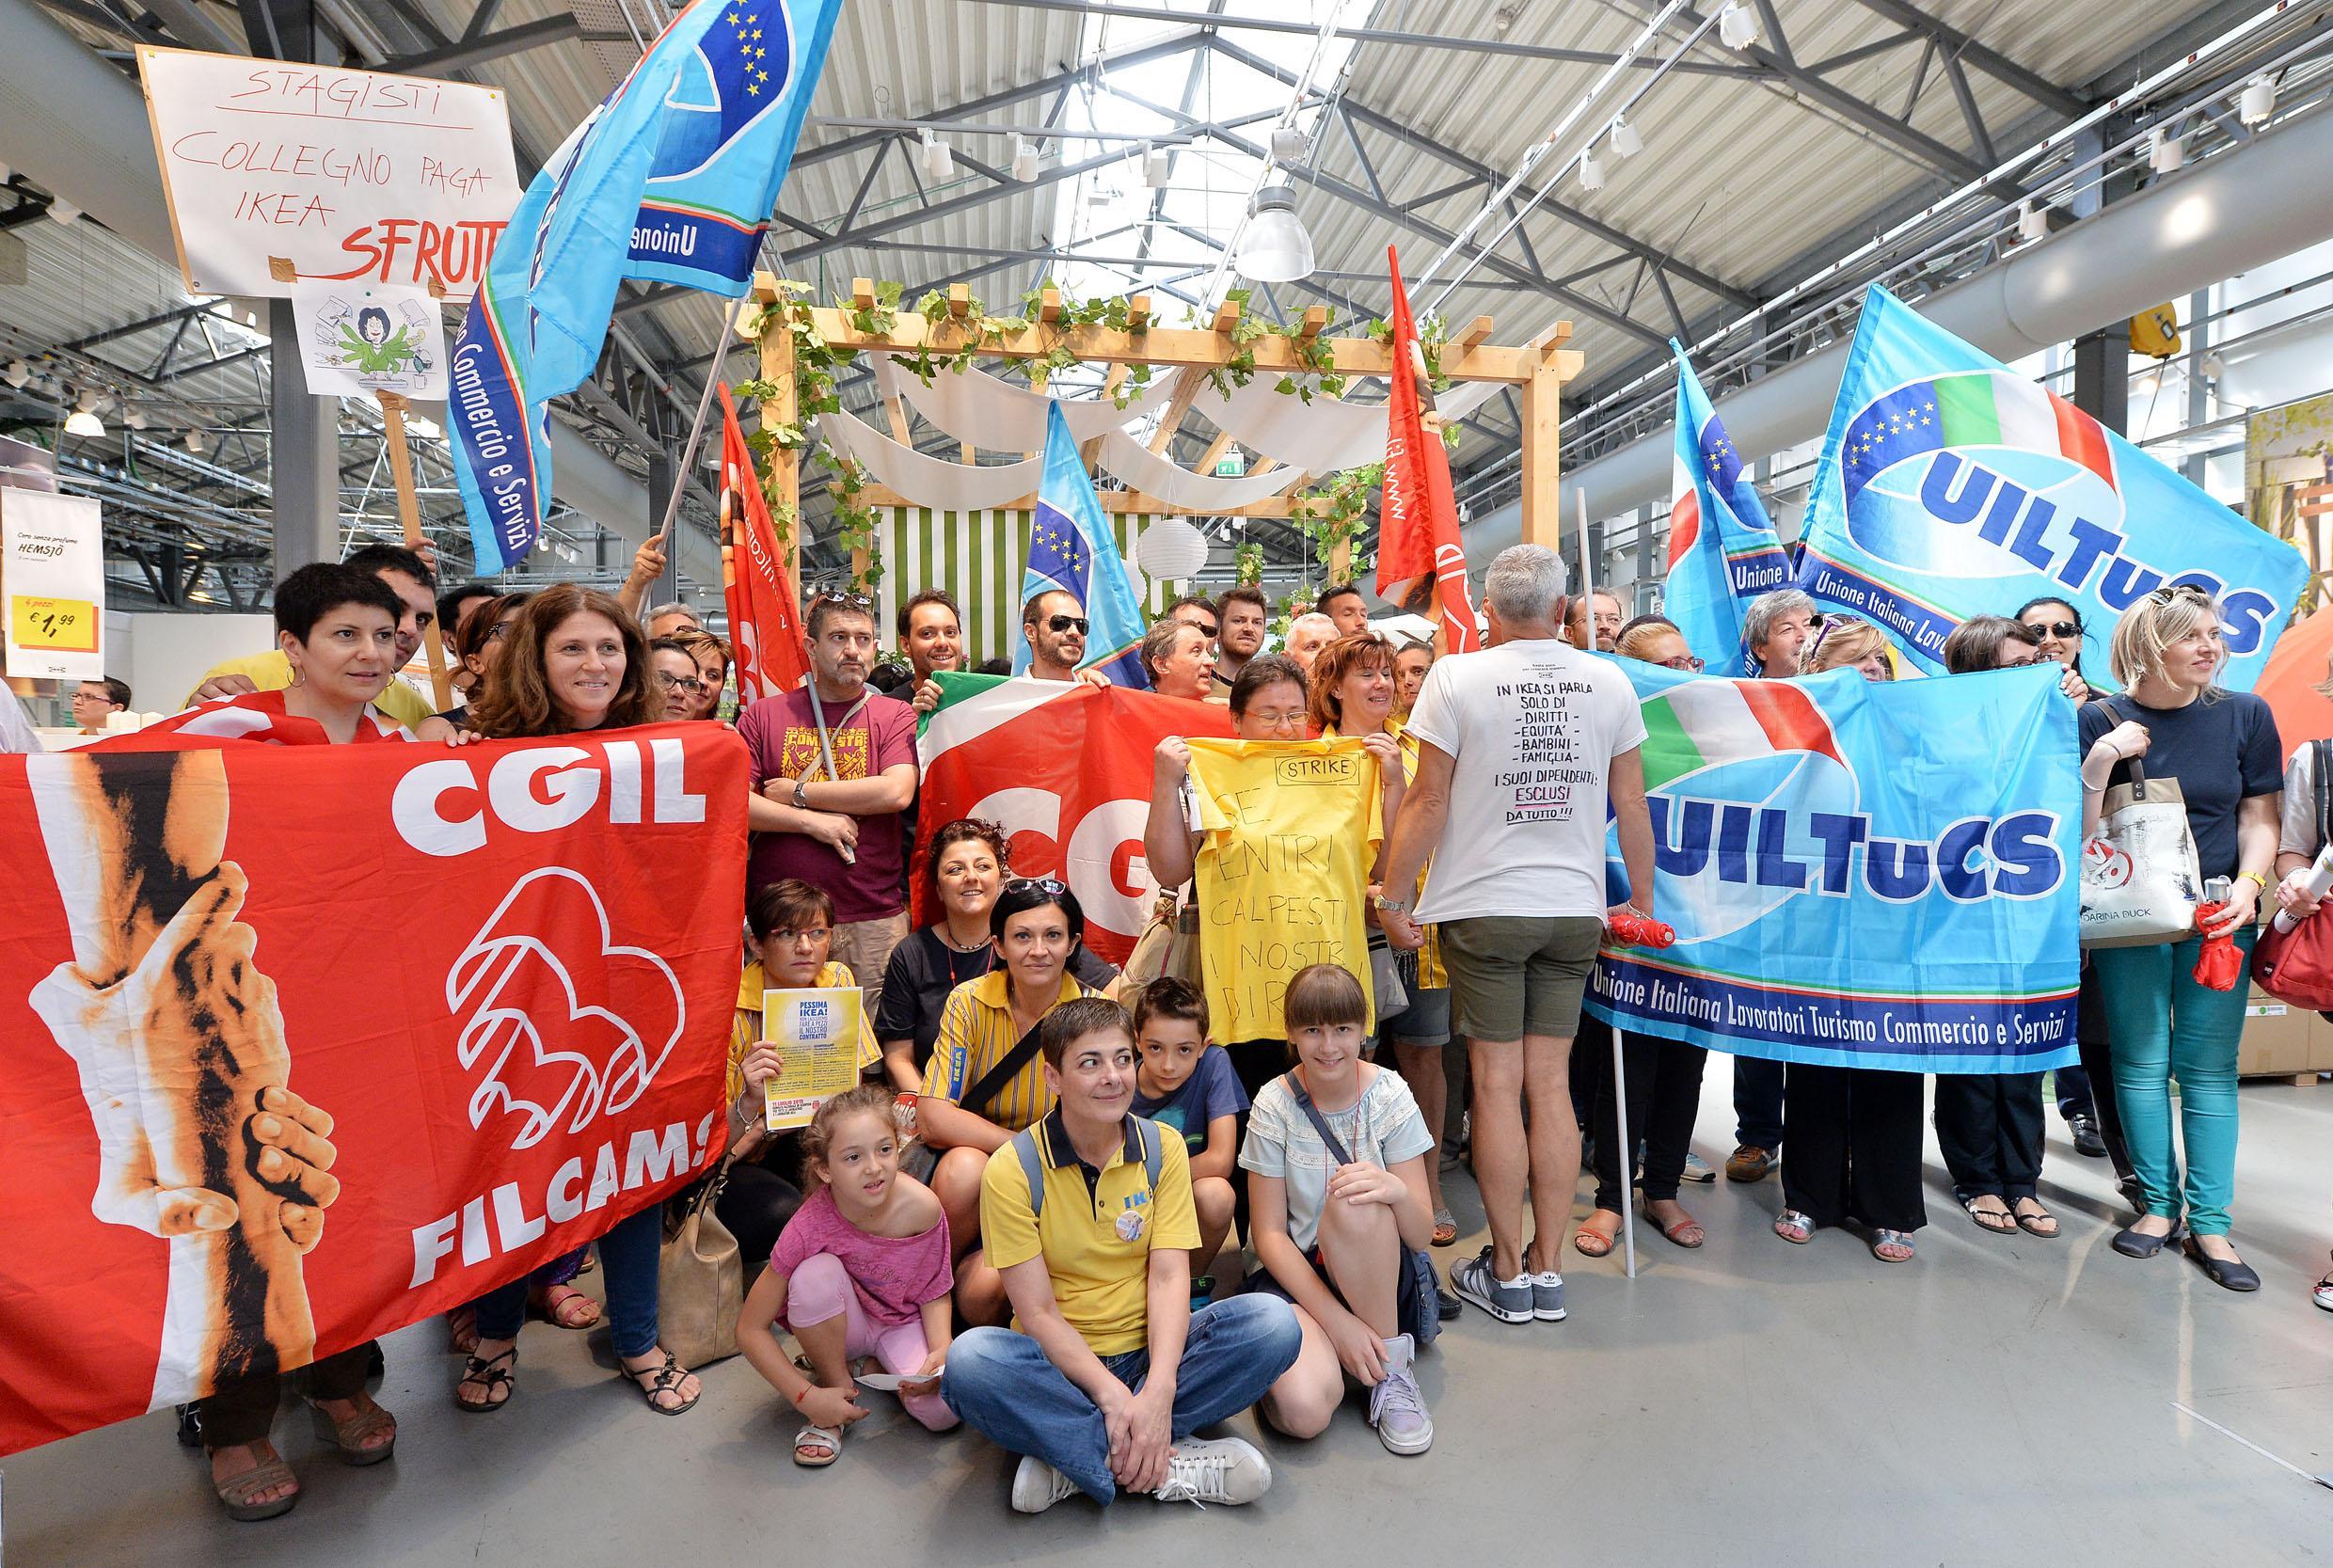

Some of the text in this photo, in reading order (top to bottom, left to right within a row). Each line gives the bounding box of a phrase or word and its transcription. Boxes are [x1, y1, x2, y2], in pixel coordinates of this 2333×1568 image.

[172, 131, 493, 198] COLLEGNO PAGA
[233, 191, 336, 227] IKEA
[453, 343, 532, 551] Commercio e Servizi
[1737, 565, 1783, 590] Unione
[1816, 569, 1865, 607] Unione
[1867, 591, 1916, 636] Italiana
[1497, 682, 1593, 697] IN IKEA SI PARLA
[1520, 696, 1566, 709] SOLO DI
[1525, 711, 1568, 725] DIRITTI
[1521, 737, 1570, 751] BAMBINI
[1288, 759, 1350, 777] STRIKE
[1521, 752, 1573, 765] FAMIGLIA
[1501, 771, 1532, 785] SUOI
[391, 738, 706, 857] CGIL
[1506, 810, 1523, 822] DA
[1218, 833, 1333, 882] ENTRI
[1643, 793, 2062, 905] UILTuCS
[1210, 895, 1348, 927] CALPESTI
[2122, 908, 2152, 919] DUCK
[800, 1001, 828, 1009] PESSIMA
[800, 1008, 828, 1017] IKEA!
[1593, 962, 2067, 1045] Unione Italiana Lavoratori Turismo Commercio e Servizi
[953, 1051, 962, 1083] IKEA
